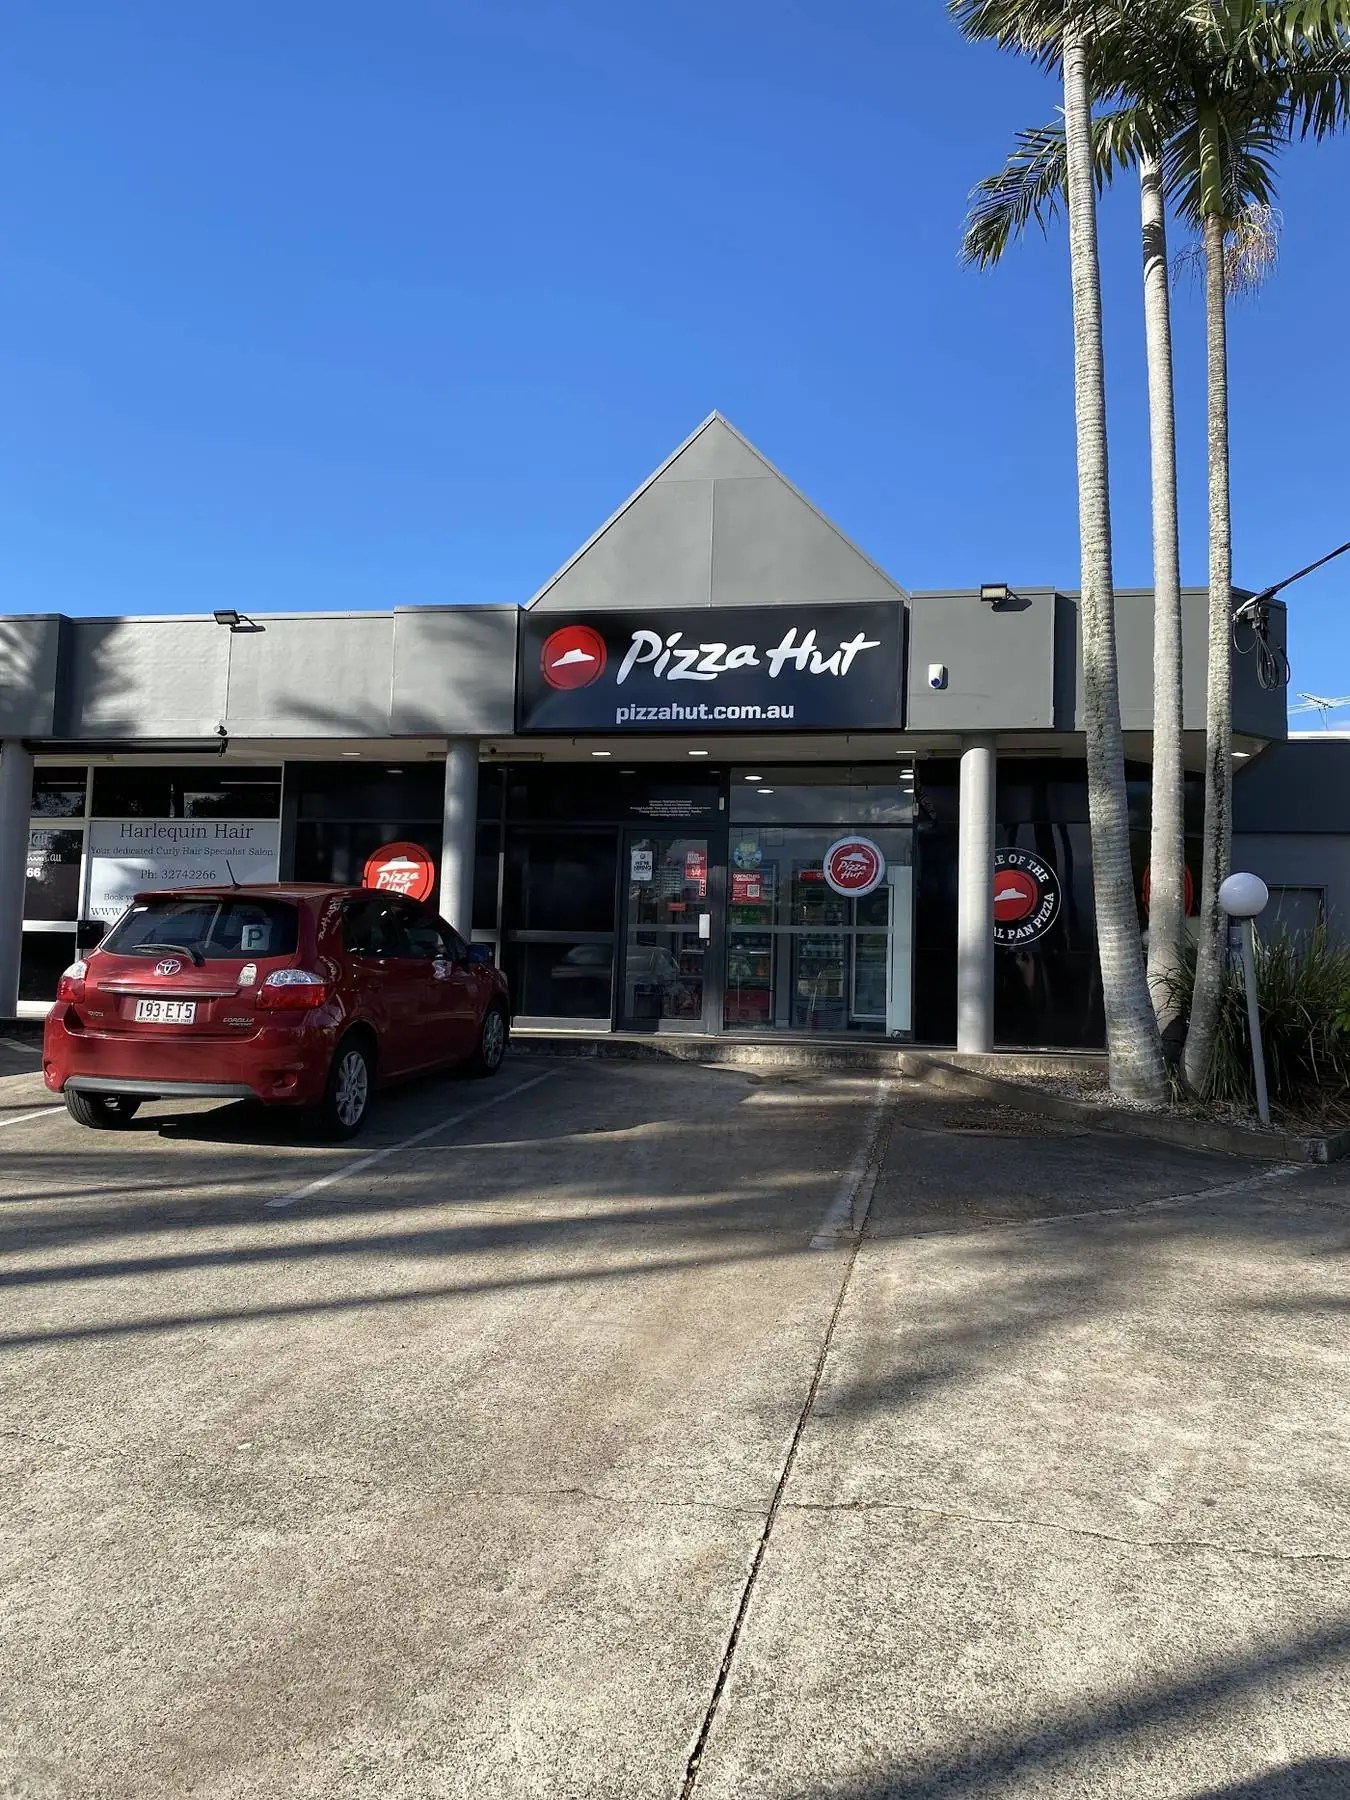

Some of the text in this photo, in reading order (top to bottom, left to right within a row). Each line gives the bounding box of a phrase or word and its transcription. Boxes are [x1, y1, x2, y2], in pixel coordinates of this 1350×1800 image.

[616, 627, 881, 685] Pizza Hut
[616, 703, 794, 724] pizzahut.com.au
[119, 823, 254, 843] Harlequin Hair
[90, 846, 110, 855] Your
[113, 846, 153, 855] dedicated
[156, 847, 179, 856] Curly
[182, 847, 202, 855] Hair
[204, 847, 246, 856] Specialist
[140, 869, 216, 880] Ph: 32742266
[837, 861, 867, 872] Pizza
[840, 871, 865, 880] Hut
[1008, 854, 1026, 865] OF
[1026, 860, 1050, 883] THE
[376, 871, 420, 889] Pizza
[103, 893, 123, 901] Book
[1007, 924, 1035, 940] PAN
[1032, 892, 1054, 929] PIZZA
[247, 928, 263, 948] P
